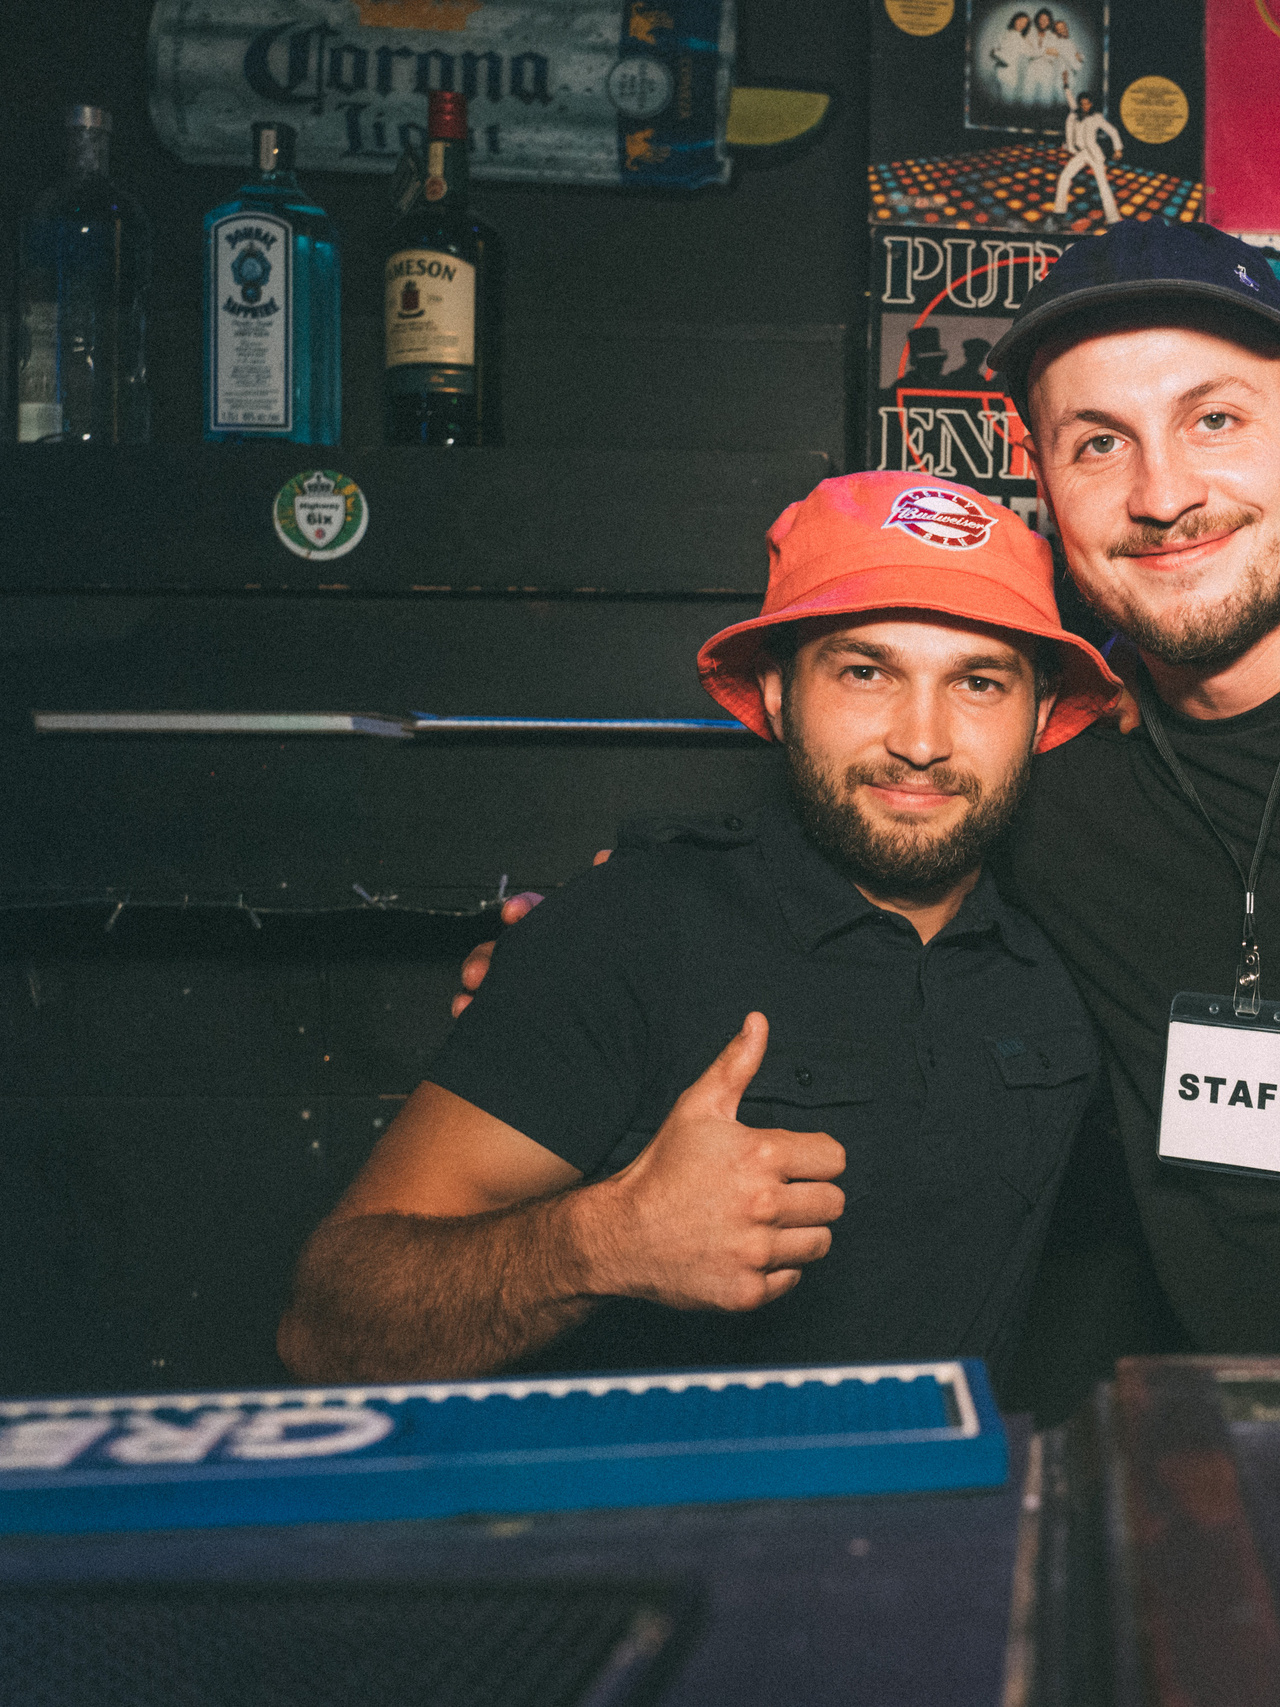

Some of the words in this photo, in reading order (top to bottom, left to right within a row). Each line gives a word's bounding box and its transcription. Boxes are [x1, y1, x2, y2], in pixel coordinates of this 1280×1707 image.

[246, 22, 553, 114] Corona
[224, 226, 278, 250] BOMBAY
[222, 296, 281, 319] SAPPHIRE
[908, 490, 974, 508] CELLY
[898, 507, 986, 530] Budweiser
